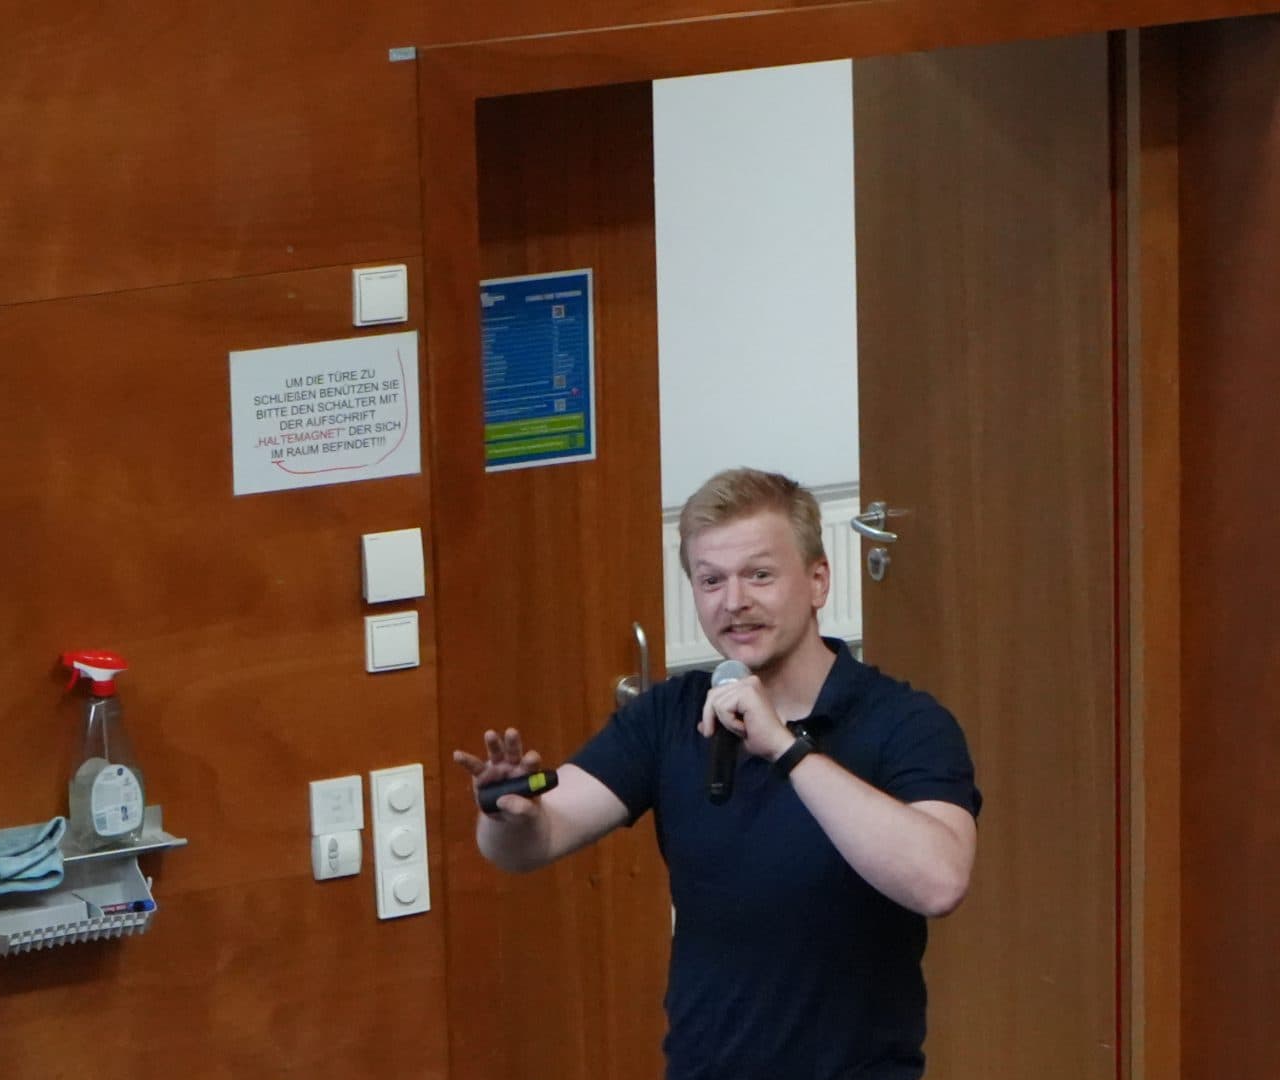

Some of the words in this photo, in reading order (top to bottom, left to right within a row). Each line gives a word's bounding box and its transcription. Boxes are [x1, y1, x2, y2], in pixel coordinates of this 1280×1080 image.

[286, 377, 302, 388] UM
[306, 374, 324, 386] DIE
[328, 370, 357, 383] TÜRE
[360, 369, 375, 379] ZU
[382, 379, 400, 391] SIE
[256, 406, 288, 420] BITTE
[291, 404, 314, 416] DEN
[318, 396, 376, 412] SCHALTER
[380, 393, 399, 404] MIT
[280, 419, 303, 431] DER
[306, 410, 376, 427] AUFSCHRIFT
[349, 424, 372, 436] DER
[376, 421, 401, 433] SICH
[271, 448, 283, 459] IM
[286, 445, 318, 457] RAUM
[322, 436, 386, 453] BEFINDET!!!
